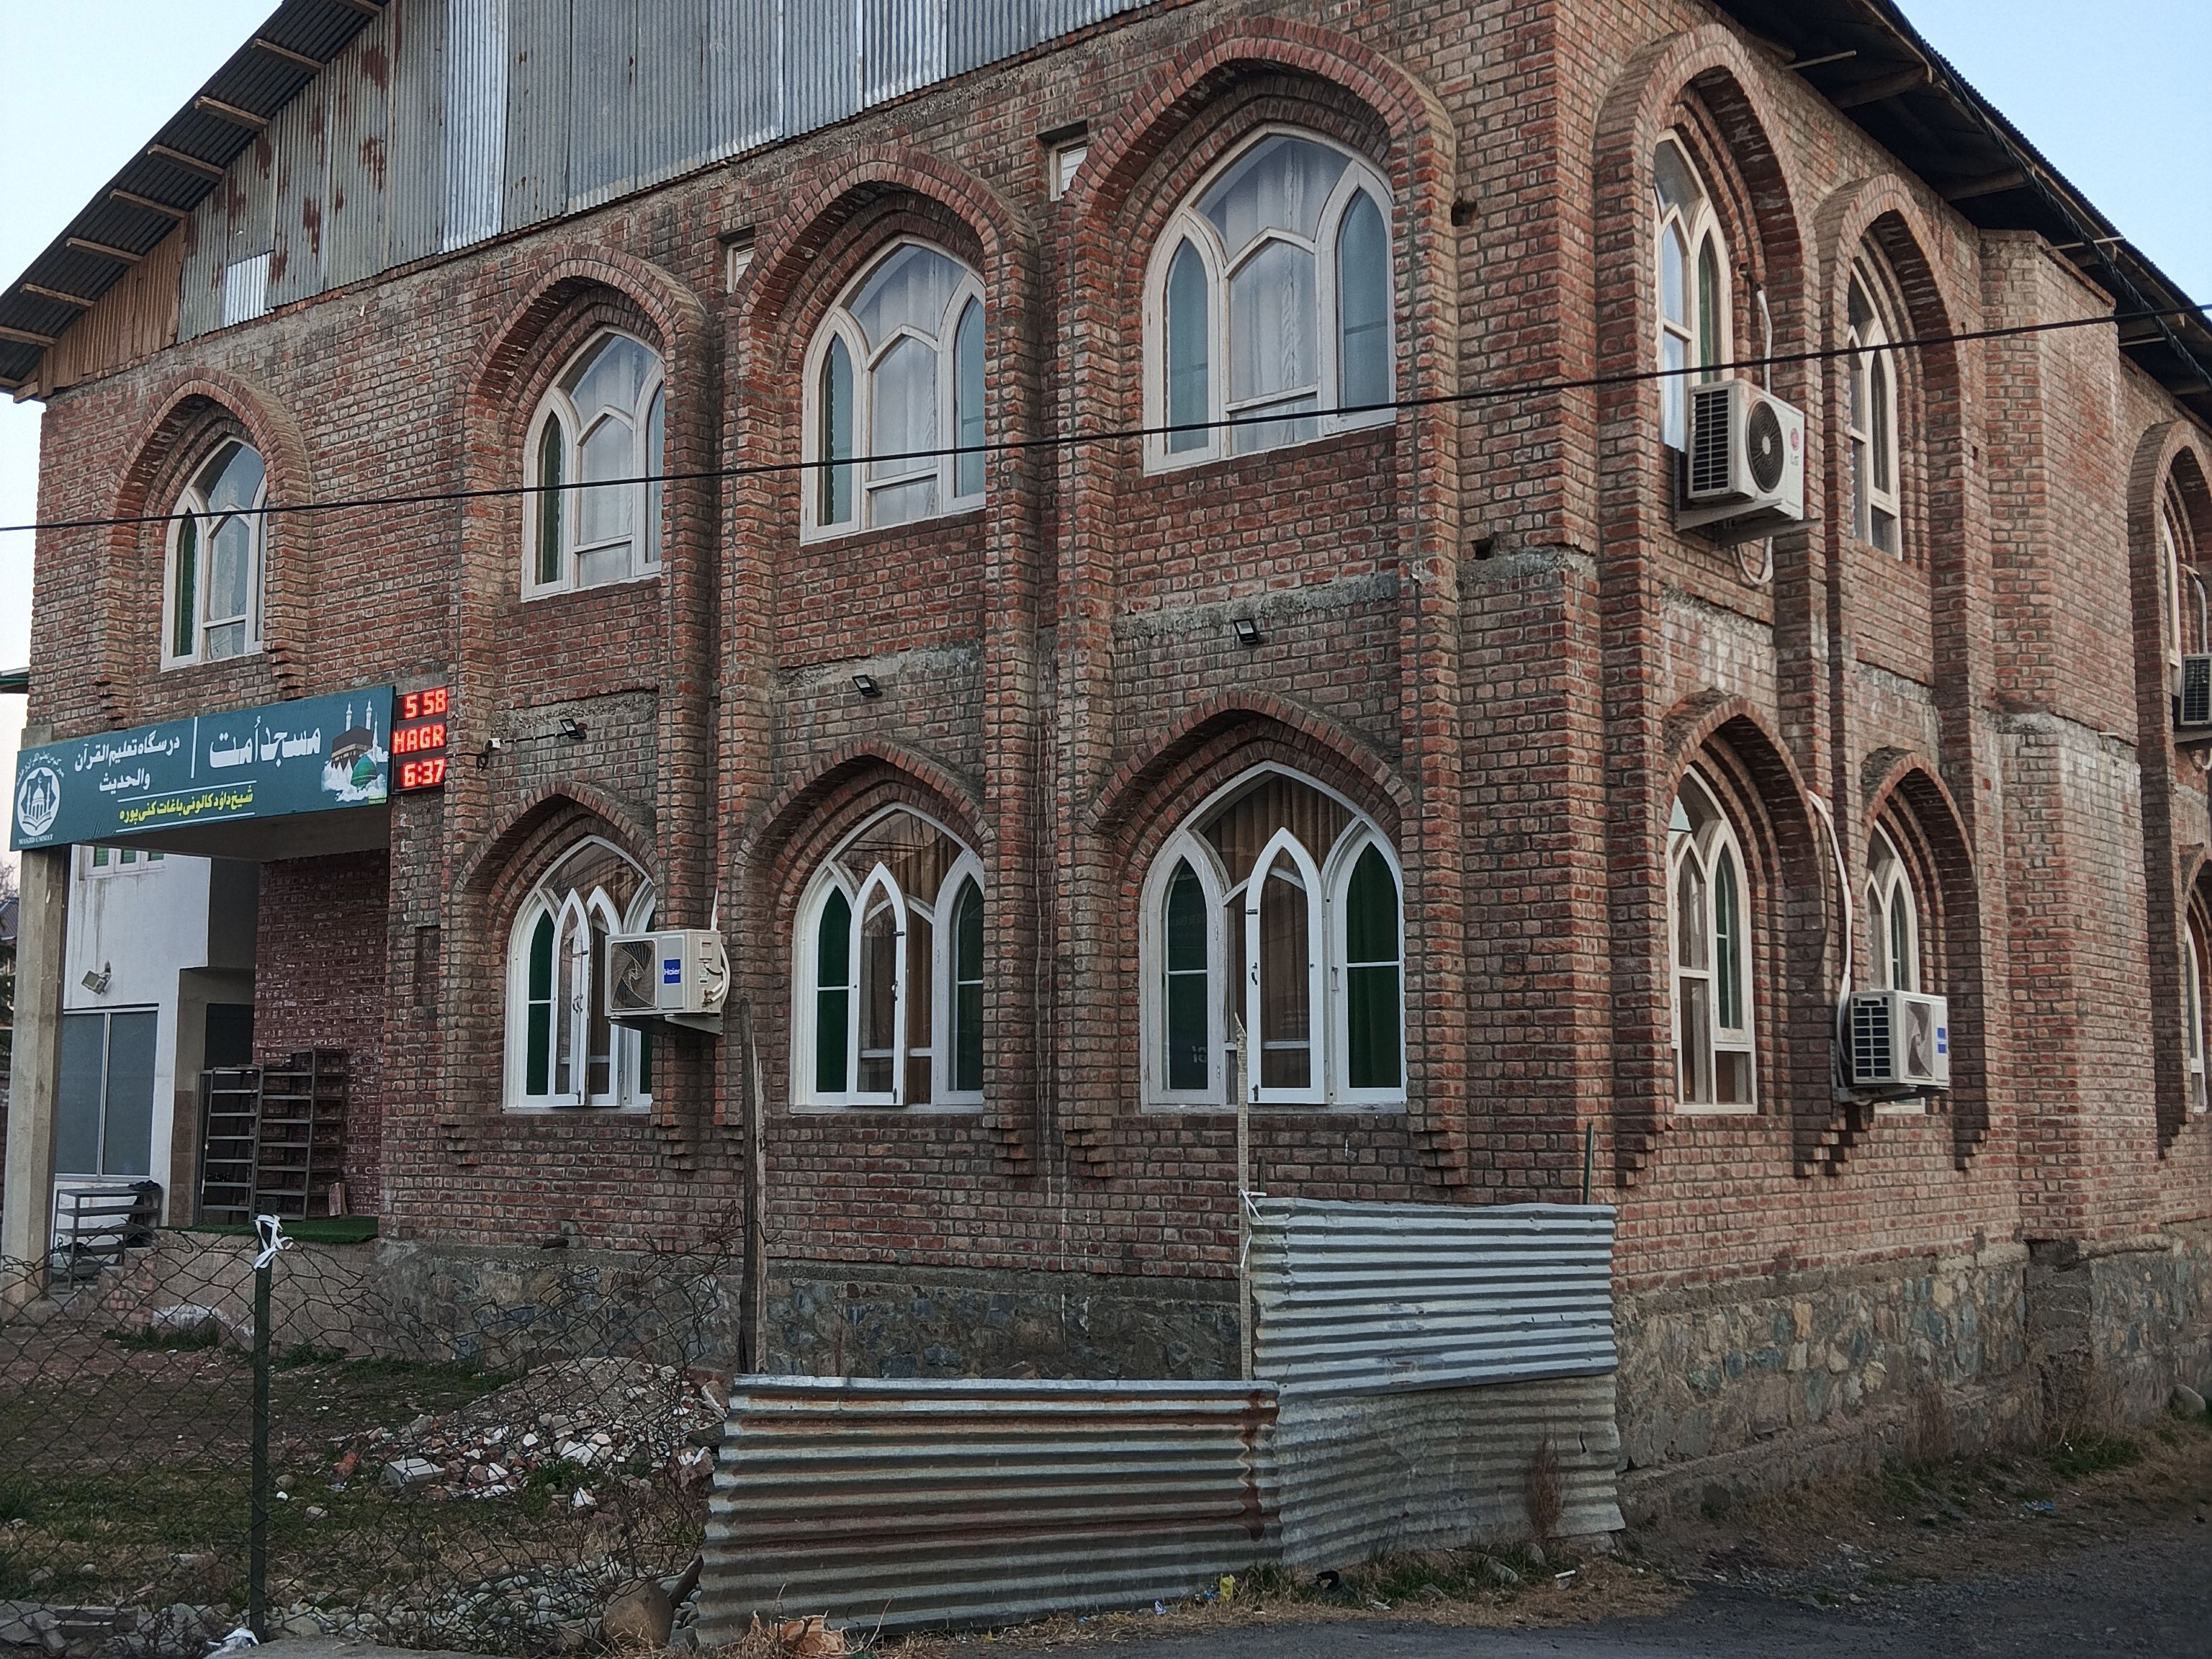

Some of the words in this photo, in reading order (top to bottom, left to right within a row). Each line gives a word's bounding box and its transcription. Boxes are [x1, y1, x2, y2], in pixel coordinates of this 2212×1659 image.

[74, 743, 109, 772] القرآن
[261, 727, 321, 768] مسجد
[403, 758, 445, 788] 6:37
[664, 967, 680, 976] Haier
